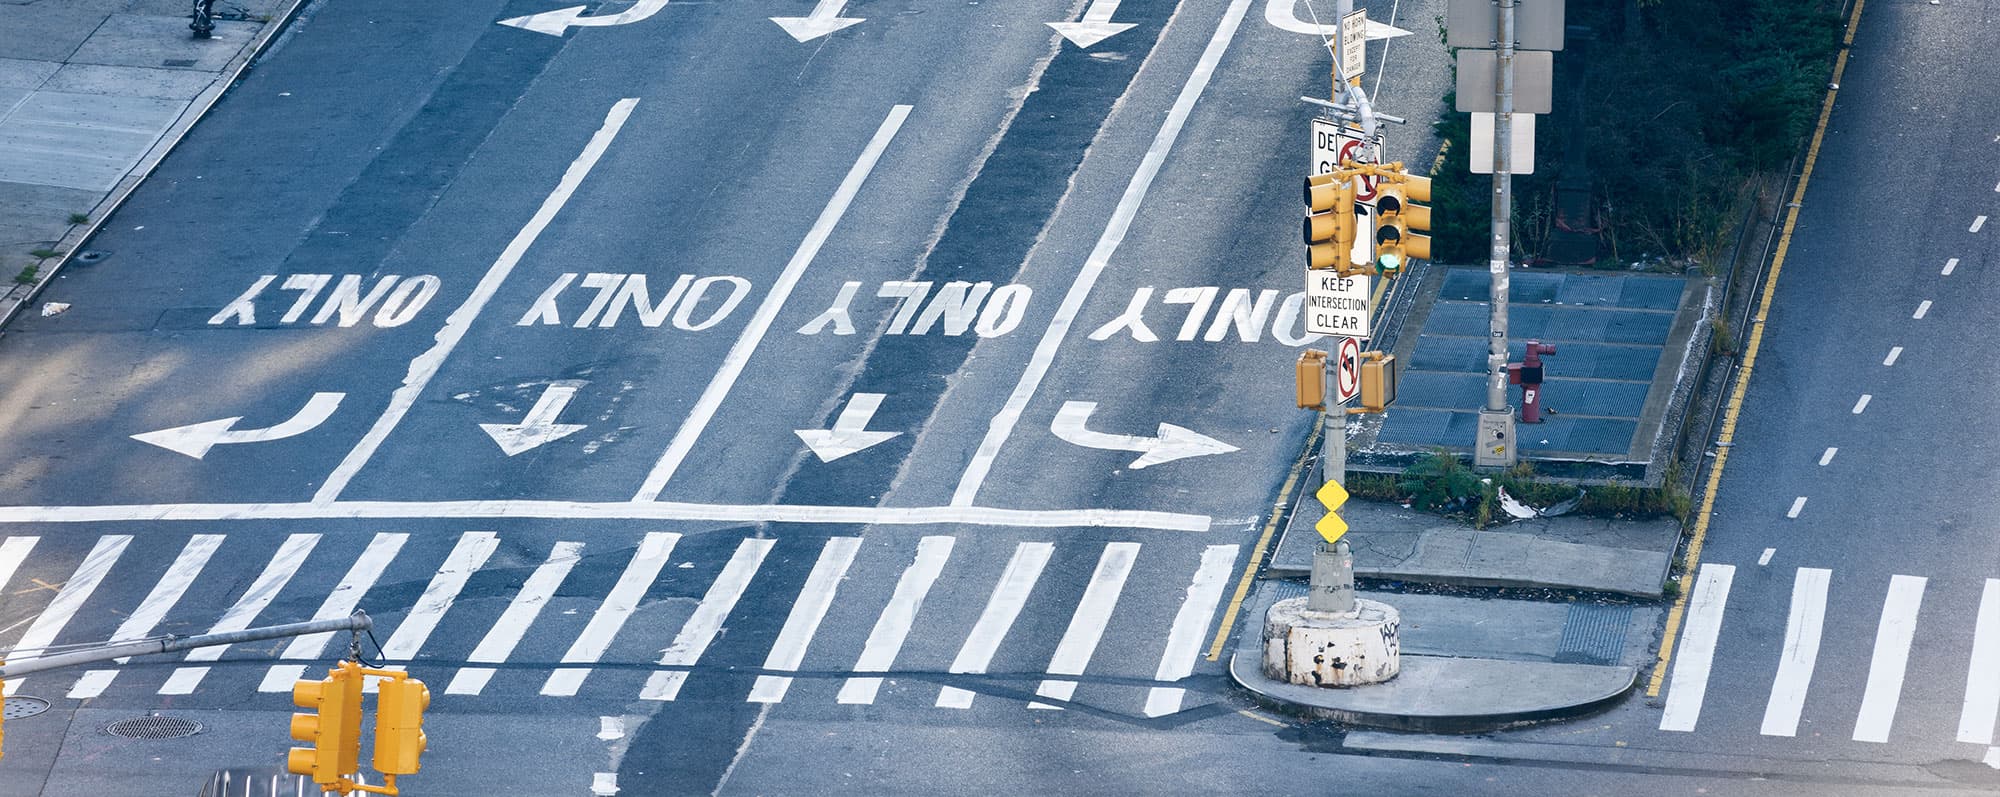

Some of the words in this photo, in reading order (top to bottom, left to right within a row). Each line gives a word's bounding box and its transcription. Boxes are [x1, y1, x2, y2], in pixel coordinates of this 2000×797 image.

[207, 274, 442, 328] ONLY
[516, 273, 752, 331] ONLY
[1321, 277, 1354, 292] KEEP
[796, 281, 1033, 338] ONLY
[1308, 295, 1367, 311] INTERSECTION
[1316, 314, 1358, 330] CLEAR
